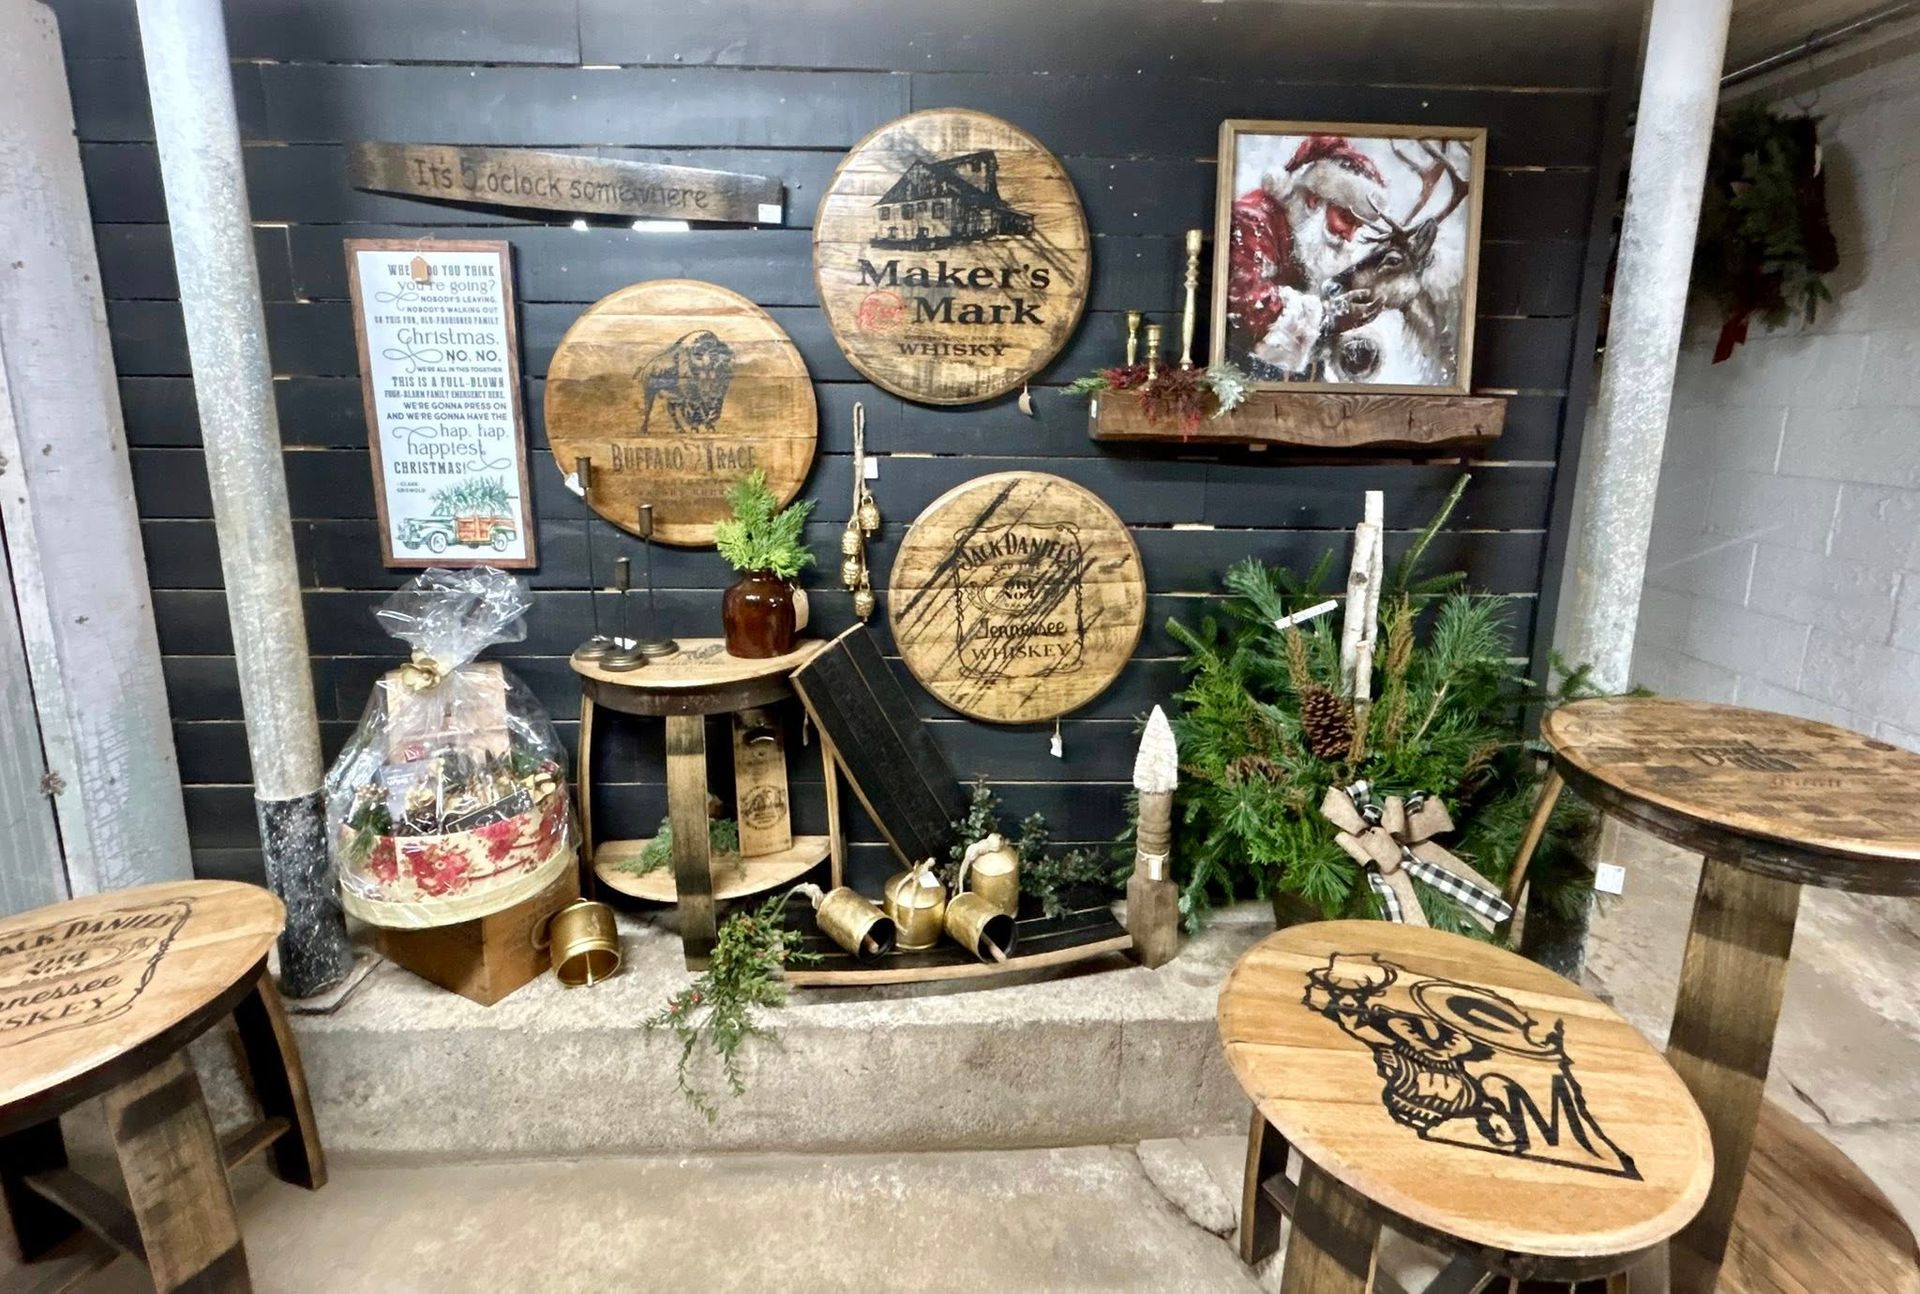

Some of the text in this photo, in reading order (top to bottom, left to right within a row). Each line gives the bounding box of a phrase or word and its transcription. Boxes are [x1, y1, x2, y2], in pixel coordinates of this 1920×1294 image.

[414, 156, 453, 189] It's
[569, 180, 709, 209] somewhere
[442, 265, 461, 276] YOU
[464, 265, 495, 277] THINK
[857, 258, 1051, 291] Maker's
[449, 280, 496, 295] going?
[911, 297, 1046, 325] Mark
[899, 342, 1008, 357] WHISKY
[392, 377, 504, 388] THIS IS A FULL-BLOWN
[403, 402, 507, 410] WE'RE GONNA PRESS ON
[610, 440, 756, 472] BUFFALO TRACE
[394, 461, 467, 475] CHRISTMAS!
[960, 540, 1003, 571] JACK
[971, 643, 1070, 661] WHISKEY
[0, 934, 54, 954] ACK
